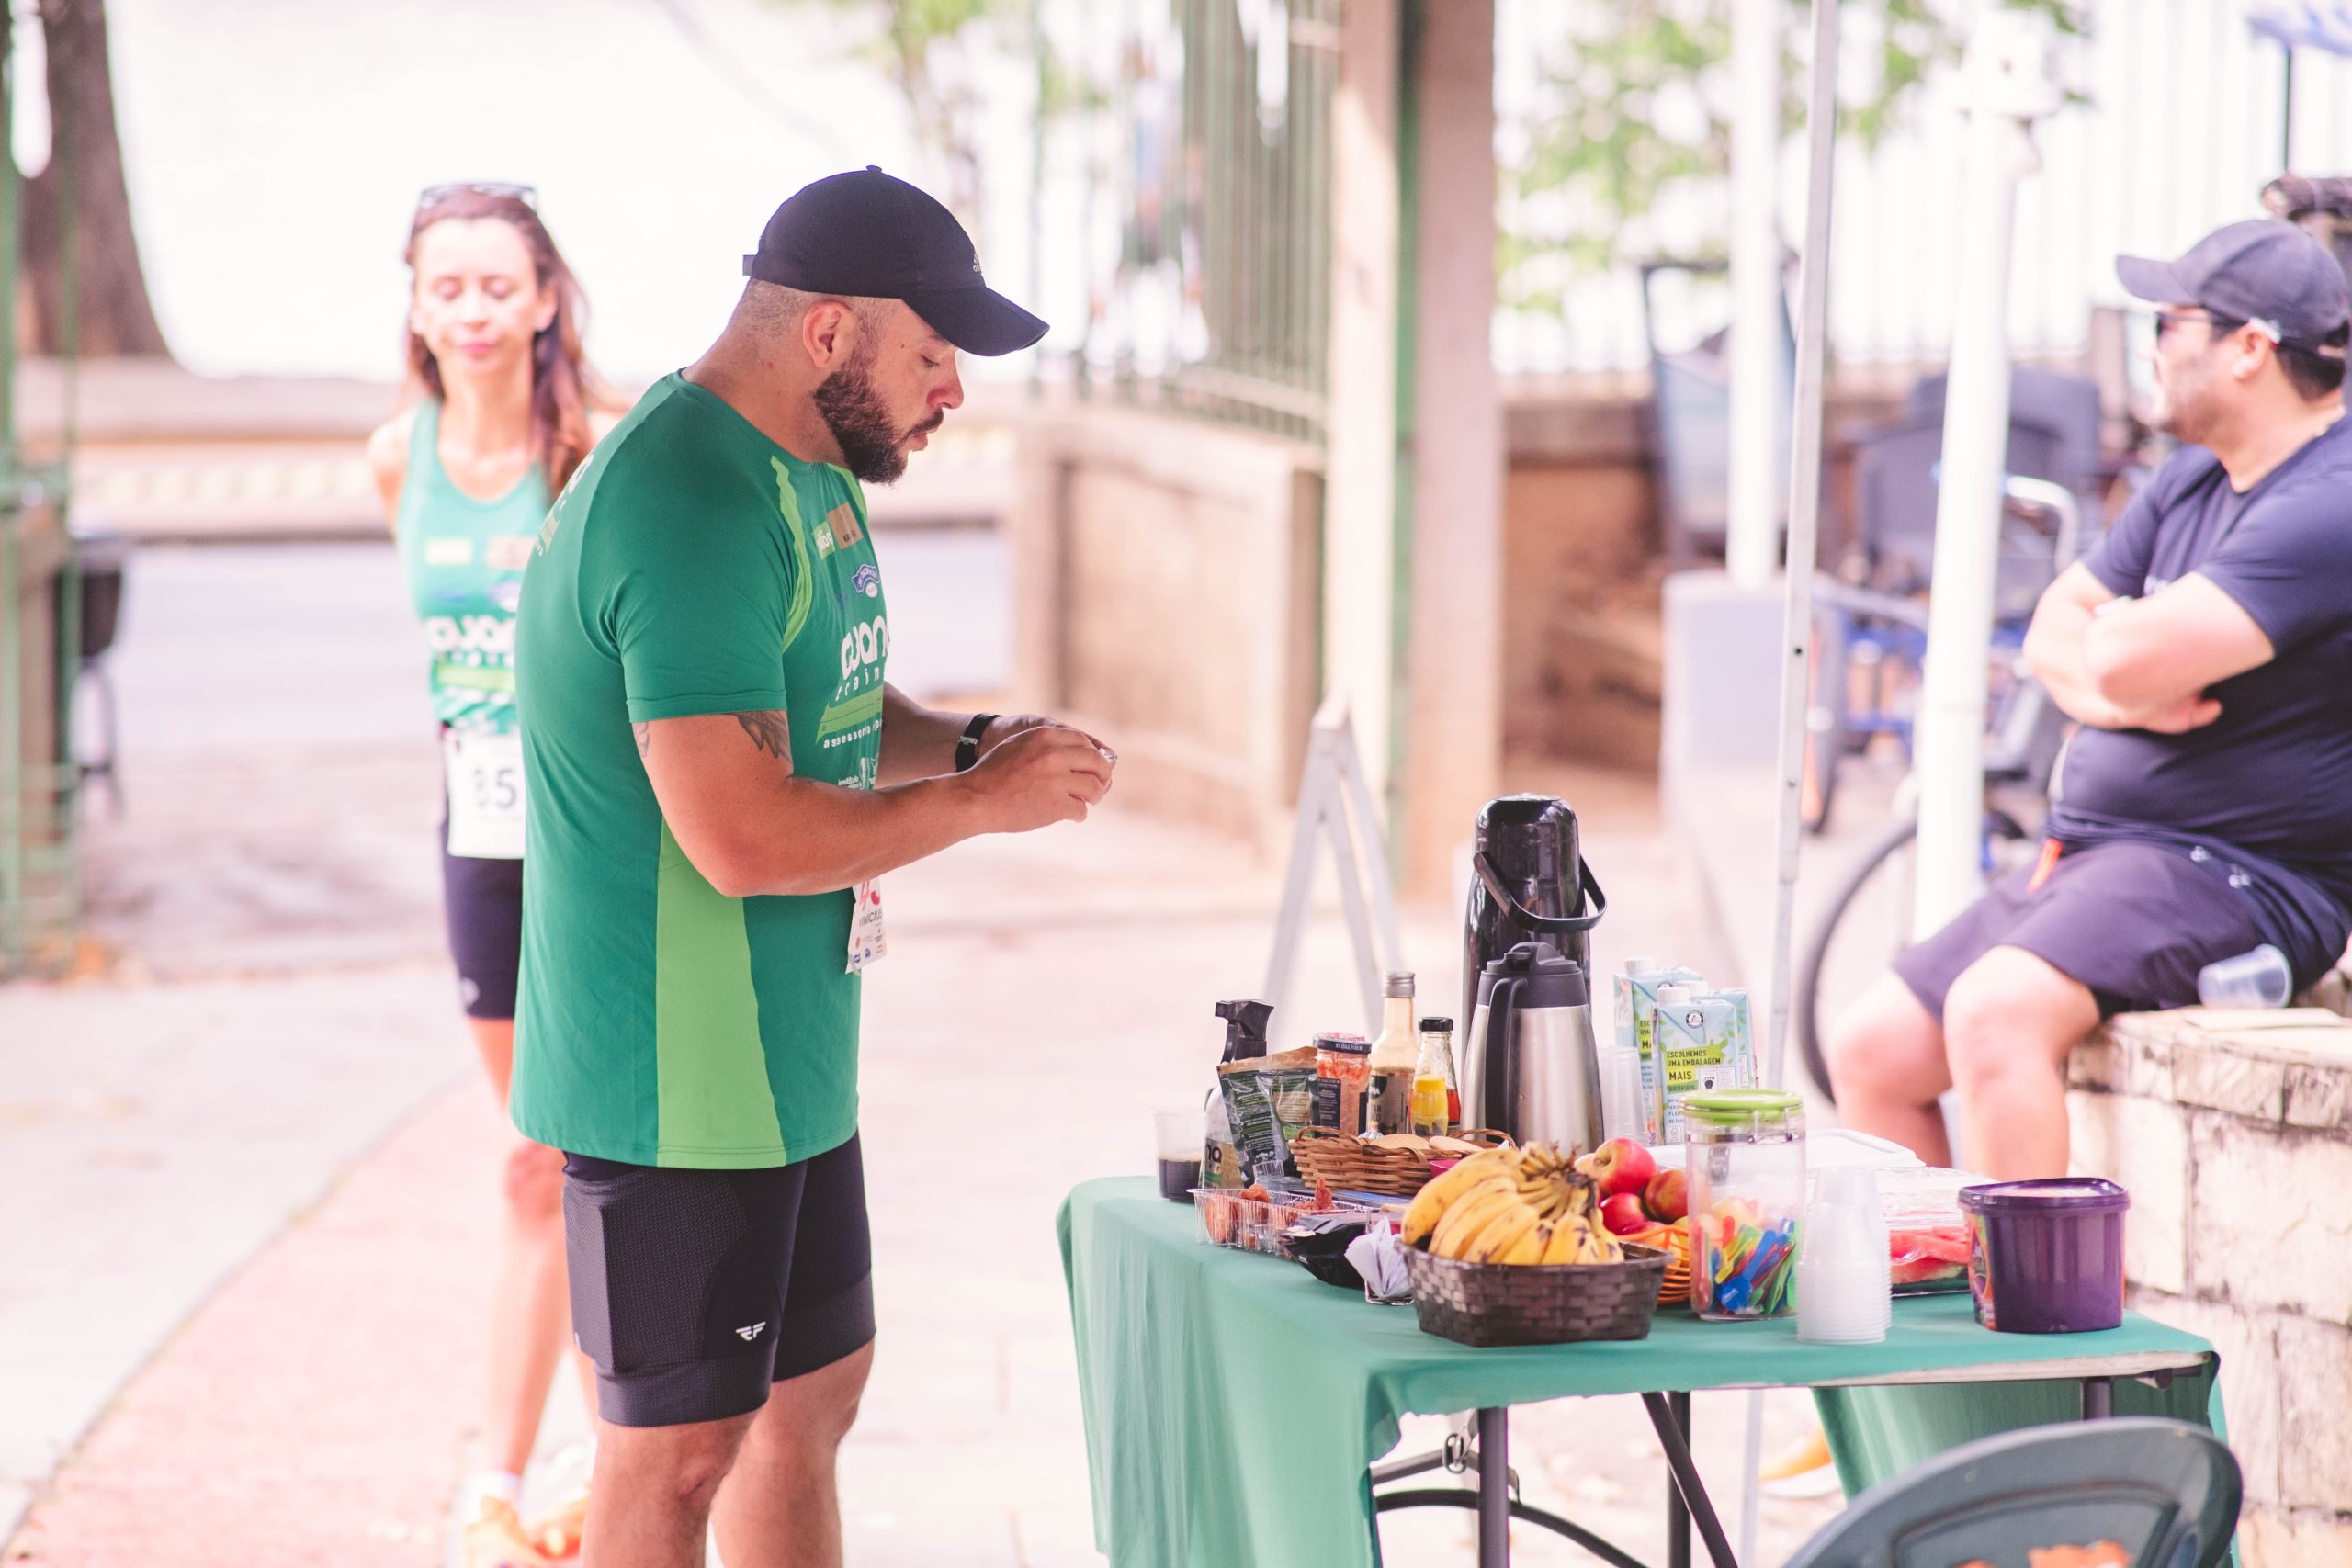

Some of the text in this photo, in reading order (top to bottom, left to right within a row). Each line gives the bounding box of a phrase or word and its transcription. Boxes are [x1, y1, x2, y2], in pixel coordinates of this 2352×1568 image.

[1667, 1049, 1707, 1058] ESCOLHEMOS
[1683, 1057, 1721, 1066] EMBALAGEM
[1668, 1071, 1692, 1081] MAIS
